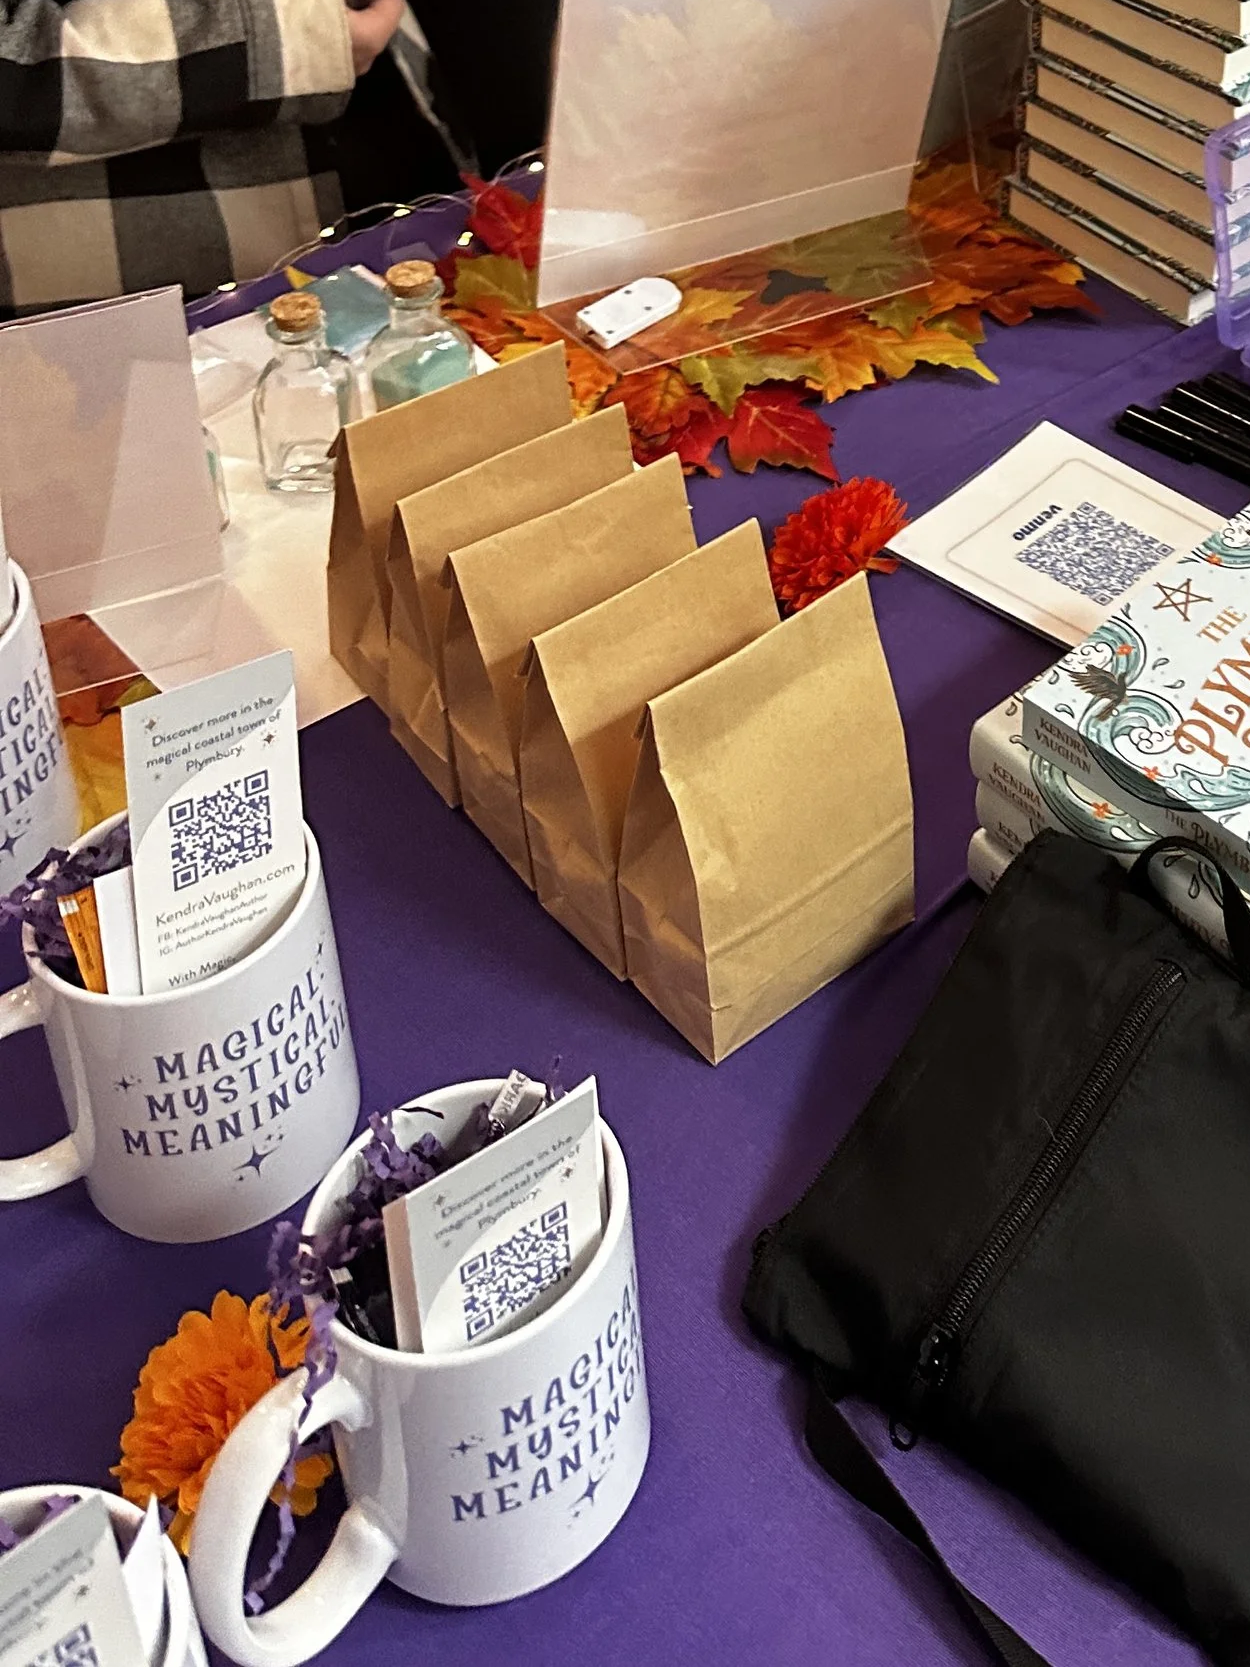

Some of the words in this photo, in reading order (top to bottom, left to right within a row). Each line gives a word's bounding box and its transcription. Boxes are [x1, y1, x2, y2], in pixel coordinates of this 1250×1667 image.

[1197, 605, 1247, 644] THE
[145, 744, 191, 768] magical
[194, 728, 235, 750] coastal
[237, 719, 266, 735] town
[267, 708, 283, 723] of
[151, 722, 204, 747] Discover
[206, 710, 238, 727] more
[240, 703, 252, 715] in
[253, 696, 274, 711] the
[1040, 717, 1089, 758] KENDRA
[1034, 729, 1092, 775] VAUGHAN
[992, 762, 1043, 809] KENDRA
[1164, 808, 1188, 829] THE
[155, 863, 296, 928] KendraVaughan.com
[168, 966, 198, 987] With
